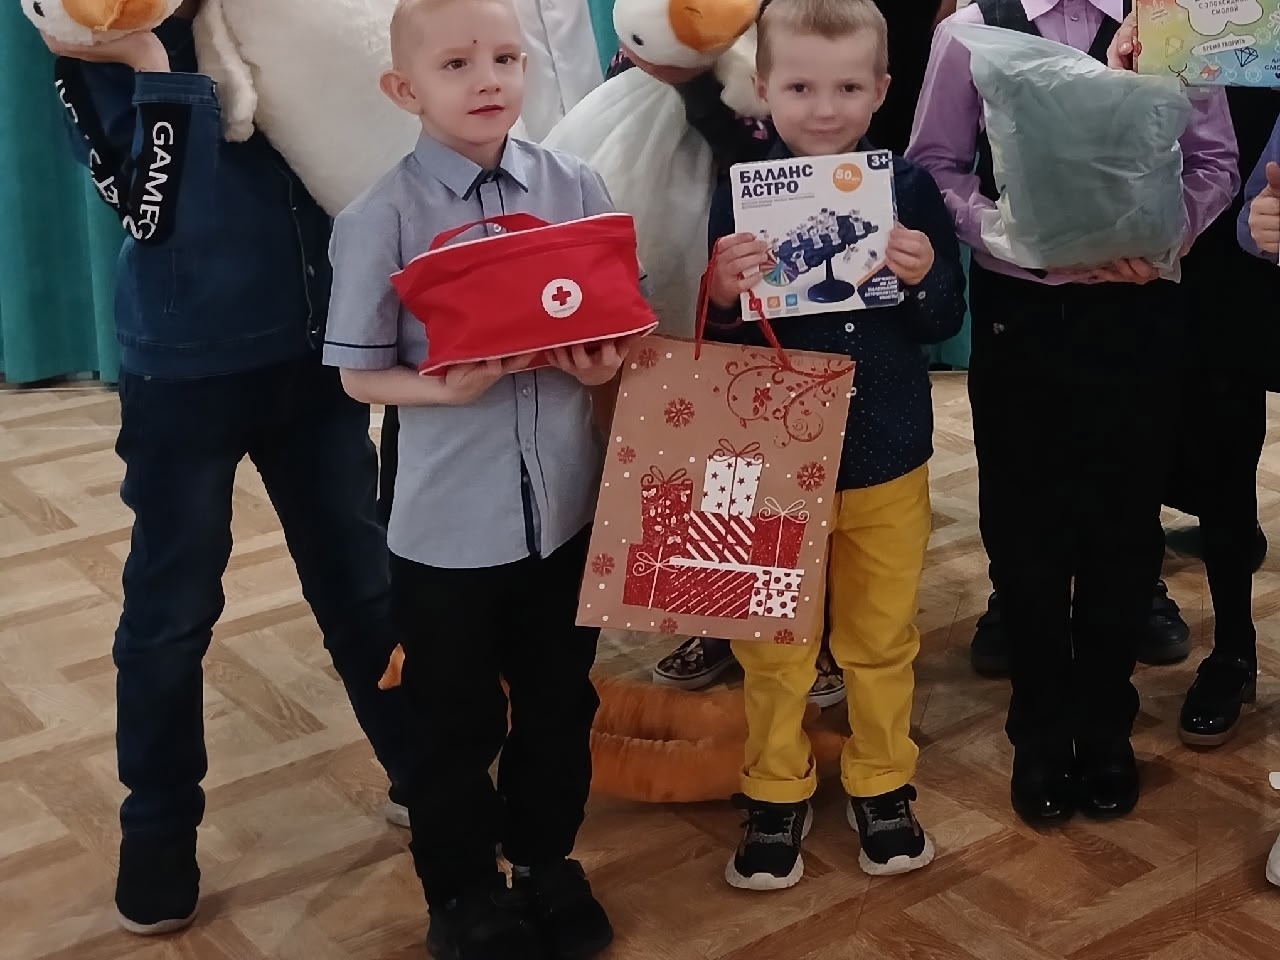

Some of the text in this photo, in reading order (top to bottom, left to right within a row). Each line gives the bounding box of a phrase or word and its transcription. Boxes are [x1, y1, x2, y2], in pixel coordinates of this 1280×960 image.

[1211, 5, 1239, 16] СМОЛОЙ
[871, 155, 889, 167] 3+
[739, 163, 814, 184] БАЛАНС
[741, 180, 799, 199] АСТРО
